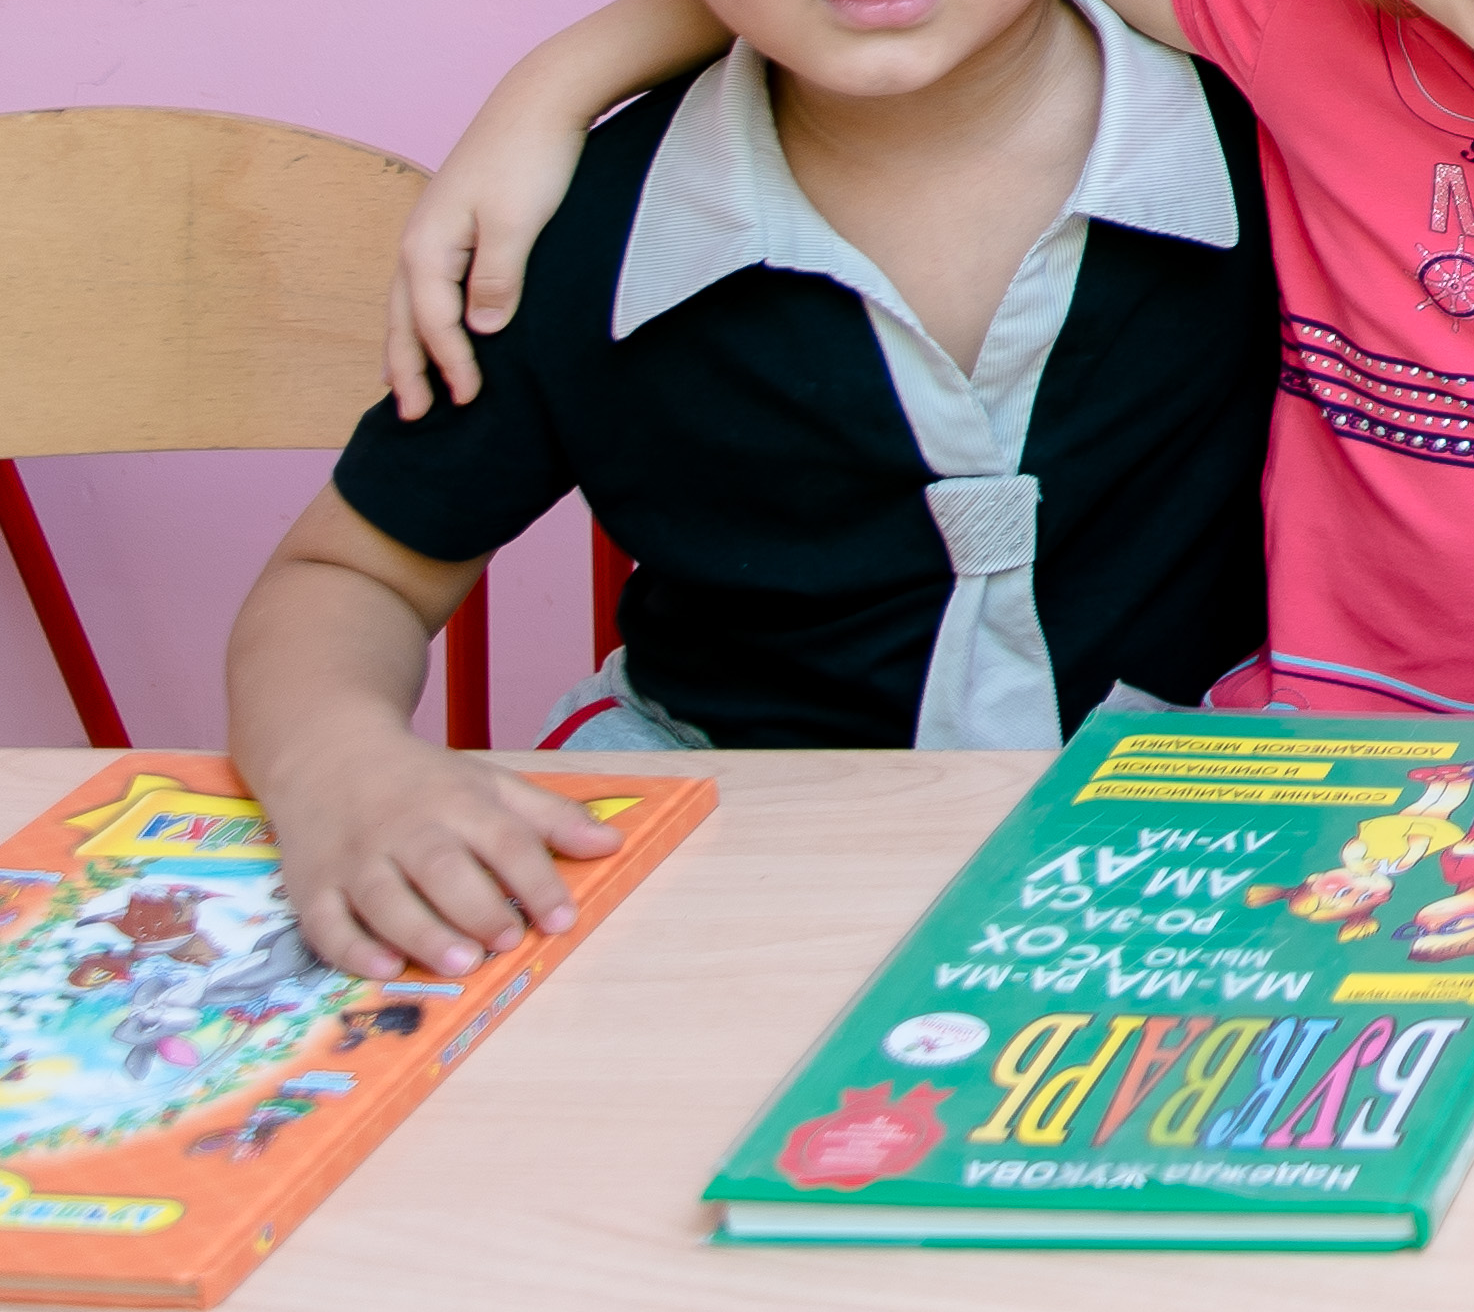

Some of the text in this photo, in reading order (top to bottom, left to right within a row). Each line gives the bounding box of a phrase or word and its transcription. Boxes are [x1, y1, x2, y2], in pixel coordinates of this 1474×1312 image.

[1130, 737, 1445, 756] ЛОГОПЕДИЧЕСКОЙ МЕТОДИКИ
[1112, 760, 1301, 777] И ОРИГИНАЛЬНОЙ
[1094, 783, 1388, 802] СОЧЕТАНИЕ ТРАДИЦИОННОЙ
[1136, 828, 1278, 851] ЛУ-НА
[1025, 844, 1254, 897] АМ АУ
[1021, 883, 1223, 933] РО-ЗА СА
[968, 923, 1275, 968] МЫ-ЛО УС ОХ
[935, 962, 1089, 990] РА-МА
[1106, 969, 1314, 1001] МА-МА
[968, 1014, 1468, 1149] БУКВАРЬ
[964, 1160, 1361, 1190] Надежда ЖУКОВА
